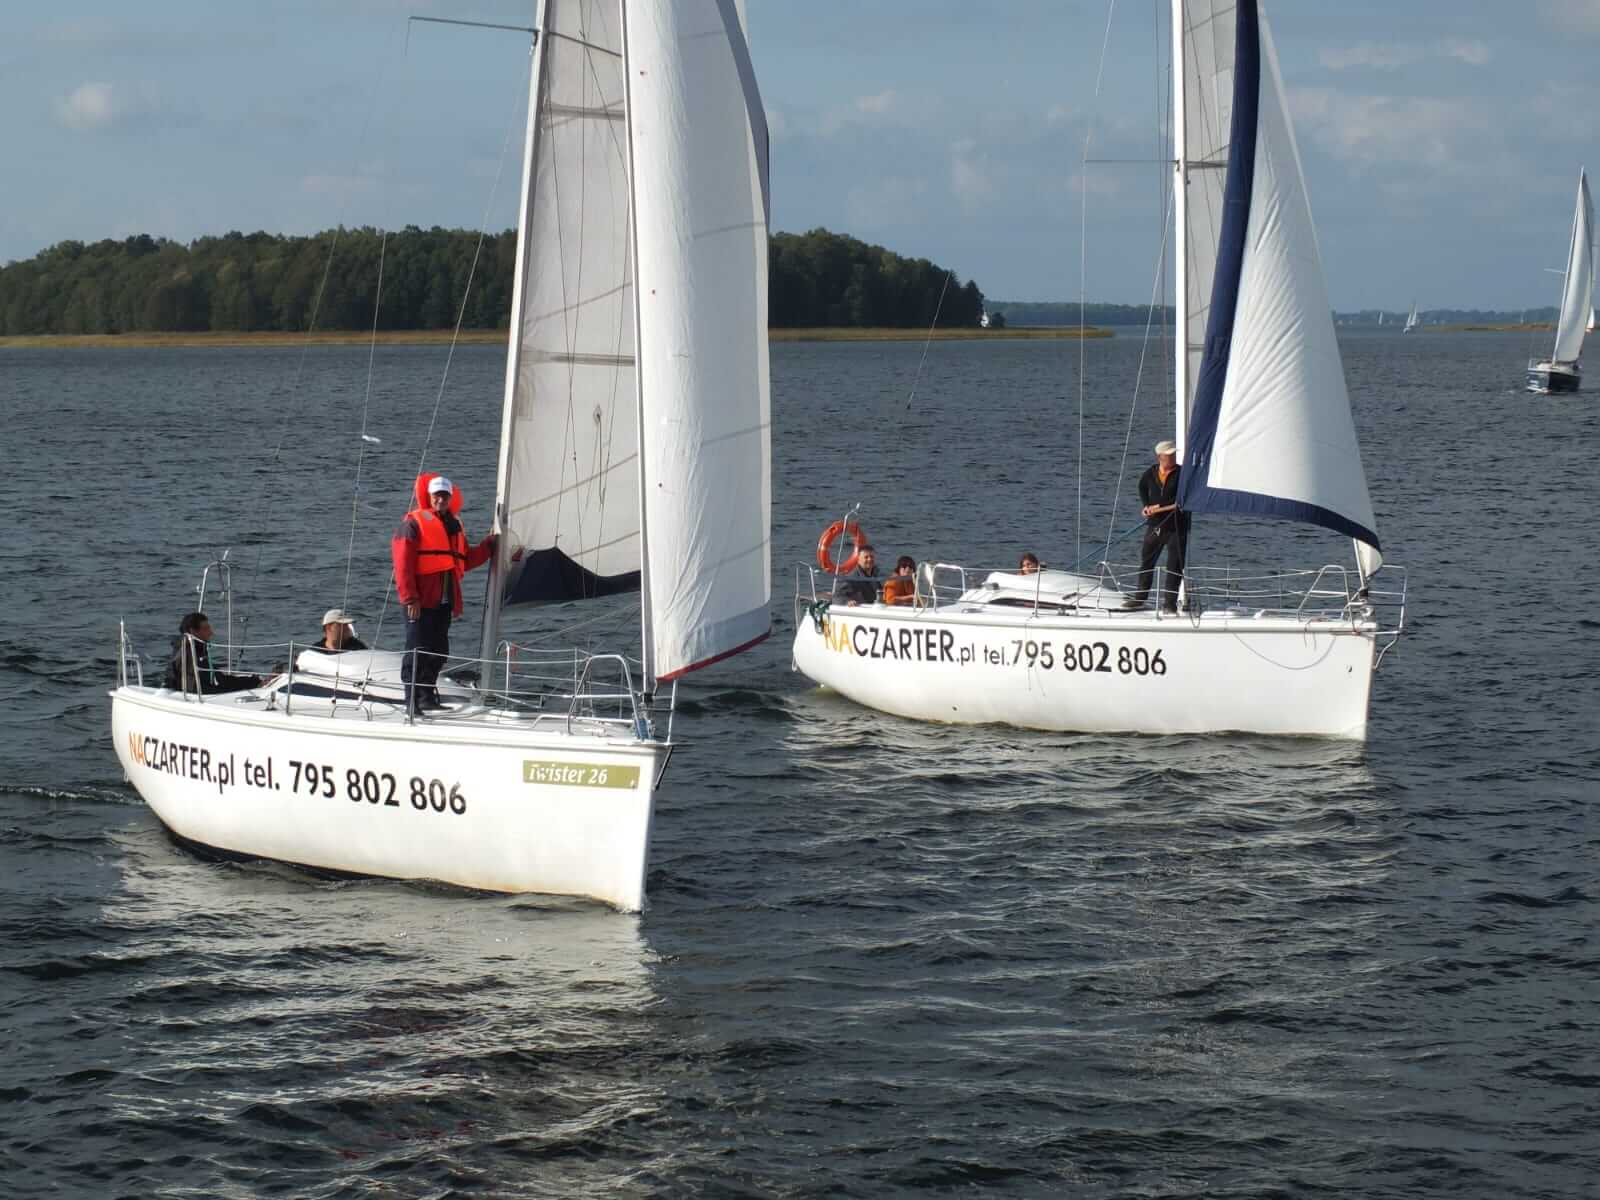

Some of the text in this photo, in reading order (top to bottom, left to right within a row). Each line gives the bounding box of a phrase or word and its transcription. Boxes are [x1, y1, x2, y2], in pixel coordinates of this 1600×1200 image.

[1010, 639, 1054, 670] 795
[1063, 642, 1112, 673] 802
[1118, 646, 1167, 676] 806
[128, 731, 467, 815] NACZARTER.pl tel. 795 802 806
[529, 763, 608, 785] Twister 26
